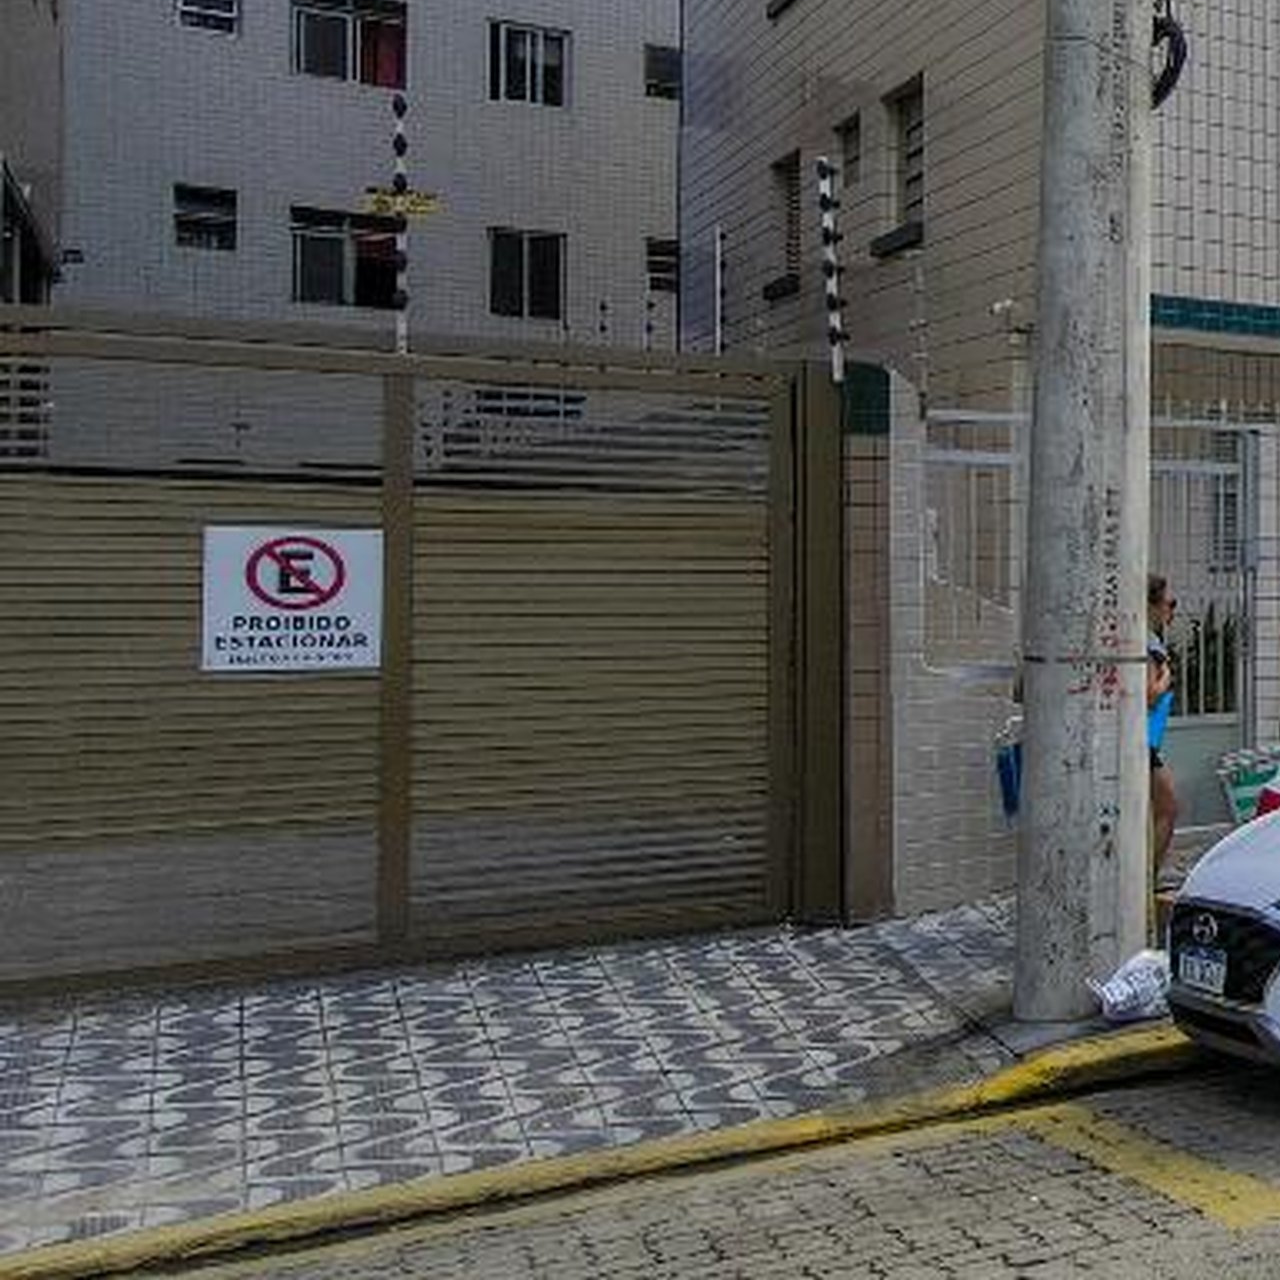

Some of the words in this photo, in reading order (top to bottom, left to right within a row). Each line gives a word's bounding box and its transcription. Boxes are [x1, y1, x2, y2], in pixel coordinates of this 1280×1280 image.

[278, 550, 316, 593] E
[232, 615, 351, 631] PROIBIDO
[215, 633, 369, 650] ESTACIONAR
